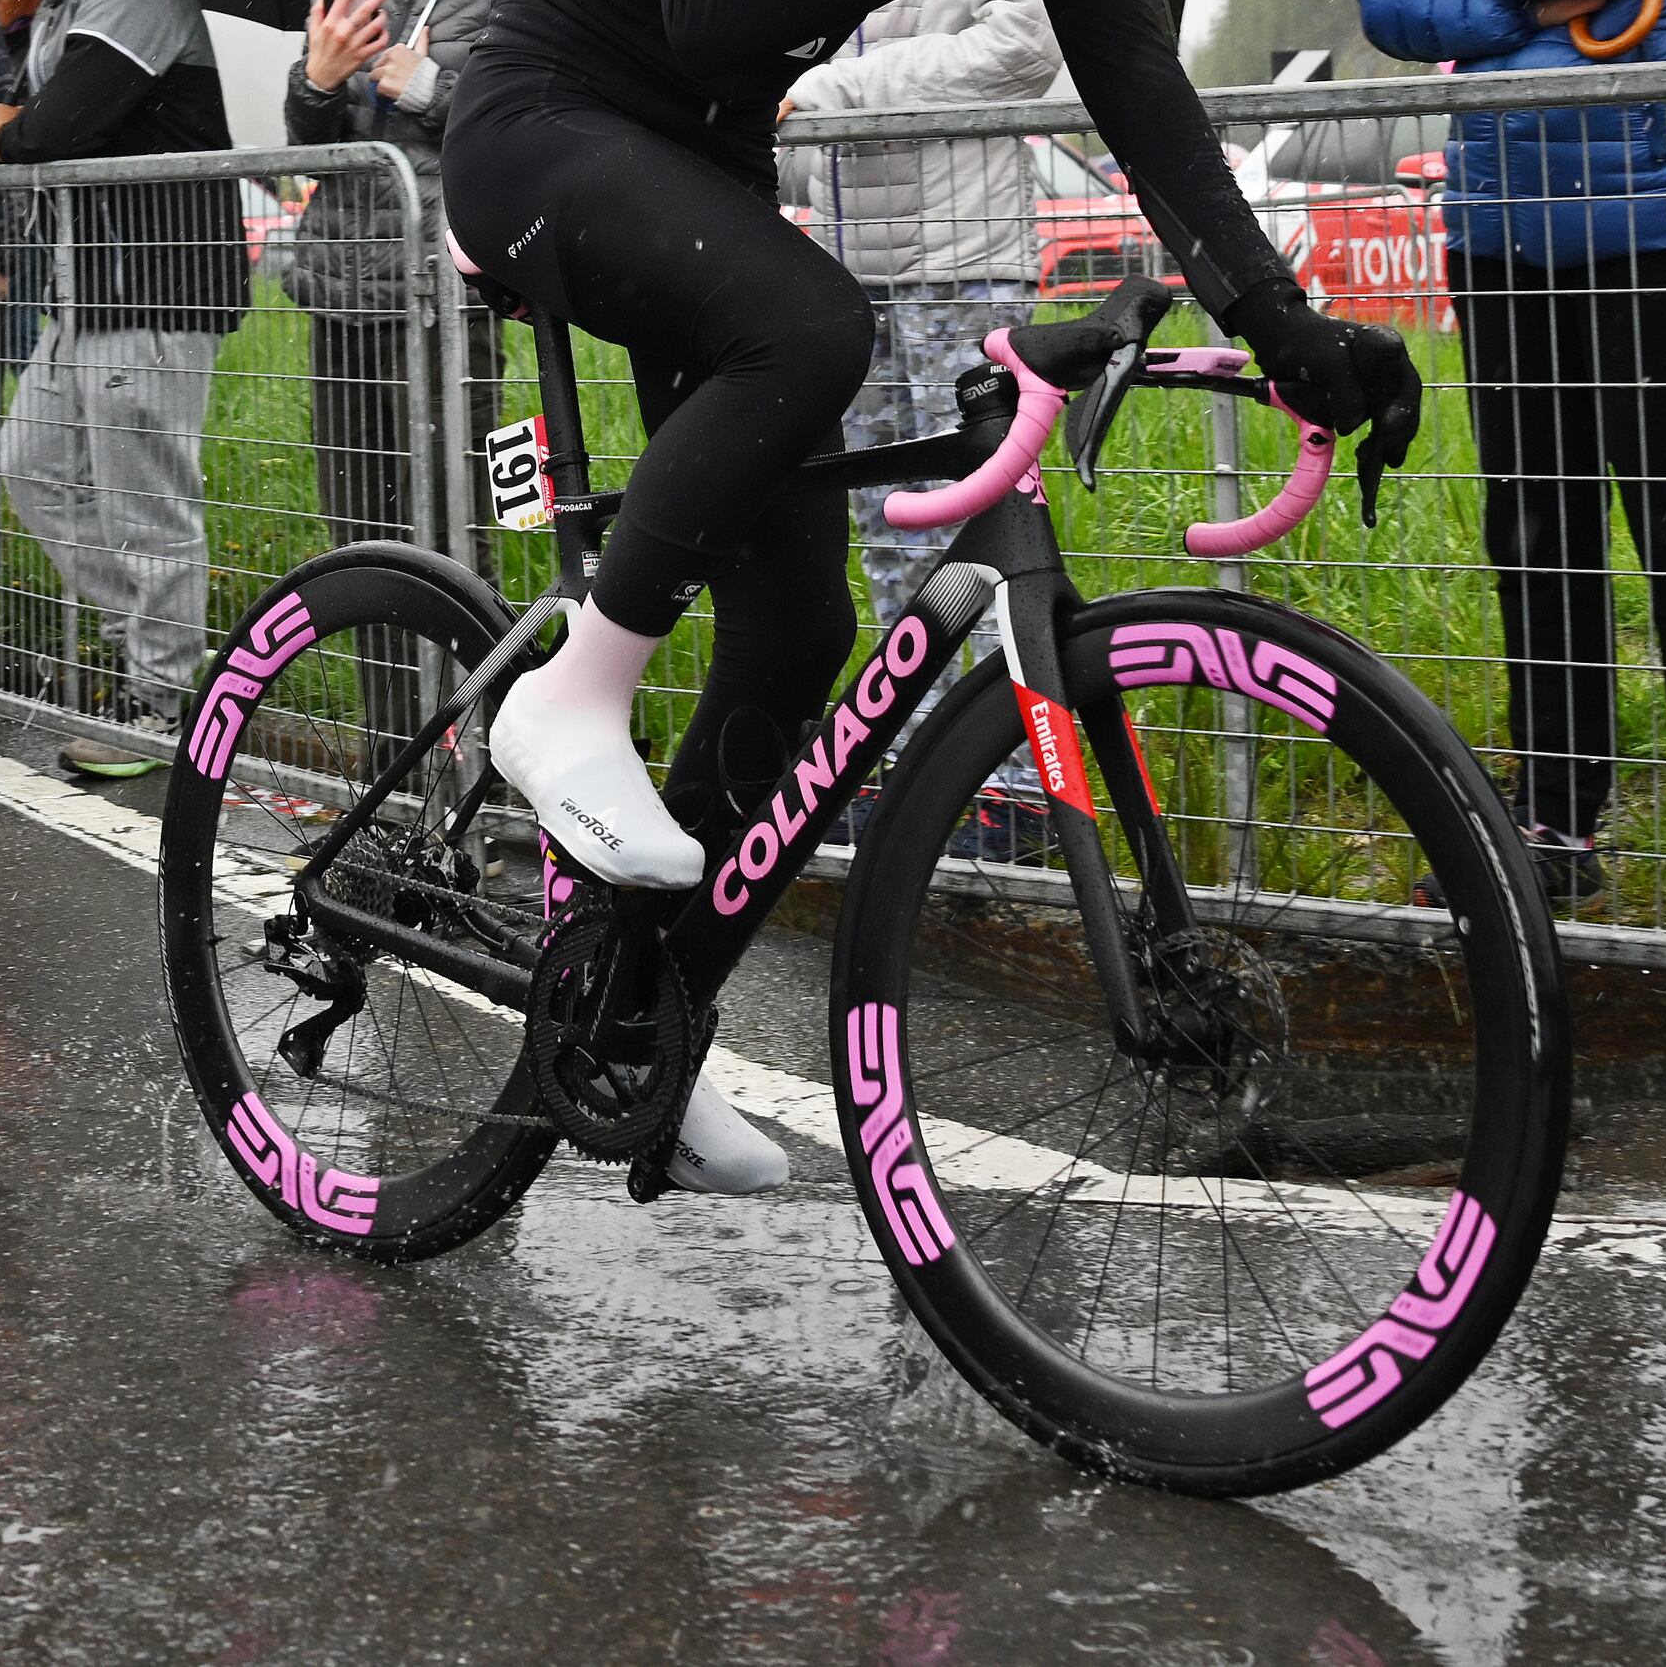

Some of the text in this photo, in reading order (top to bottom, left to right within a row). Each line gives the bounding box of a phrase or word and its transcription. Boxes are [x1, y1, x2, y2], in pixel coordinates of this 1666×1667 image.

[516, 216, 545, 251] PISSEI
[1348, 233, 1447, 286] TOYOT
[488, 426, 540, 520] 191
[712, 614, 928, 917] COLNAGO
[1030, 700, 1065, 793] Emirates
